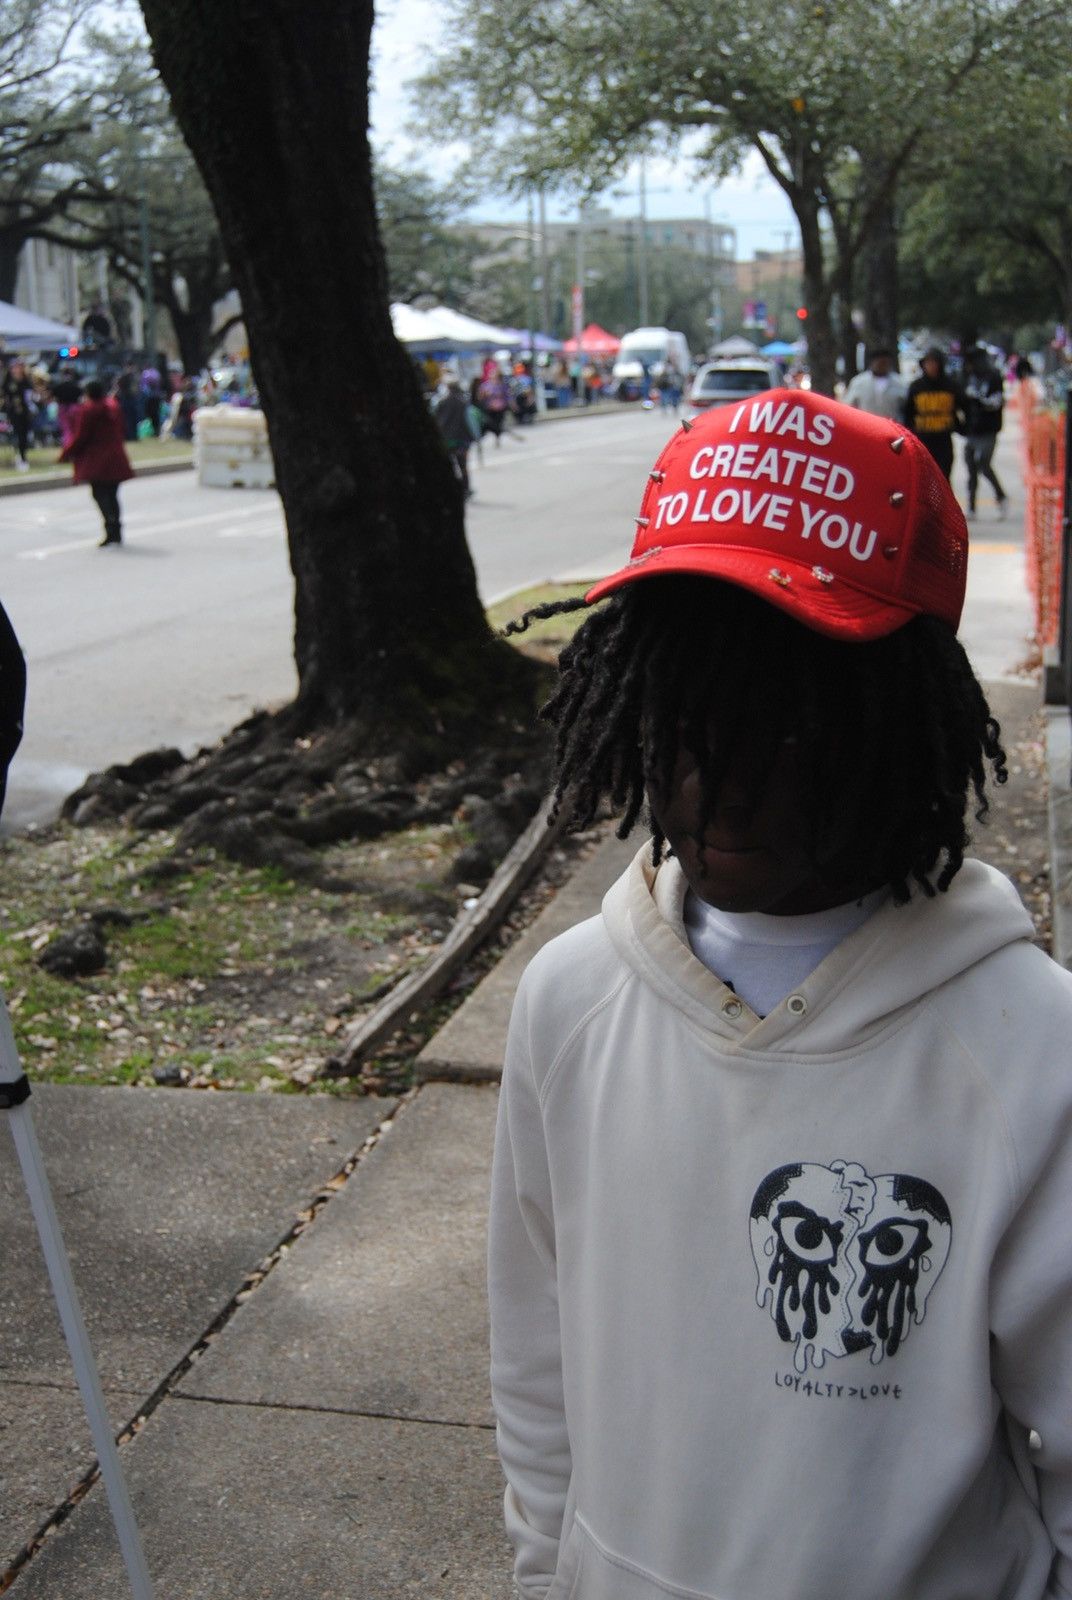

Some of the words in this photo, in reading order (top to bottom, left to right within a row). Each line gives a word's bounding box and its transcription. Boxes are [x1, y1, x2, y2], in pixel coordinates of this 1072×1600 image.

[729, 405, 746, 432] I
[749, 401, 835, 445] WAS
[690, 444, 855, 501] CREATED
[656, 492, 689, 529] TO
[691, 488, 794, 531] LOVE
[799, 502, 877, 561] YOU
